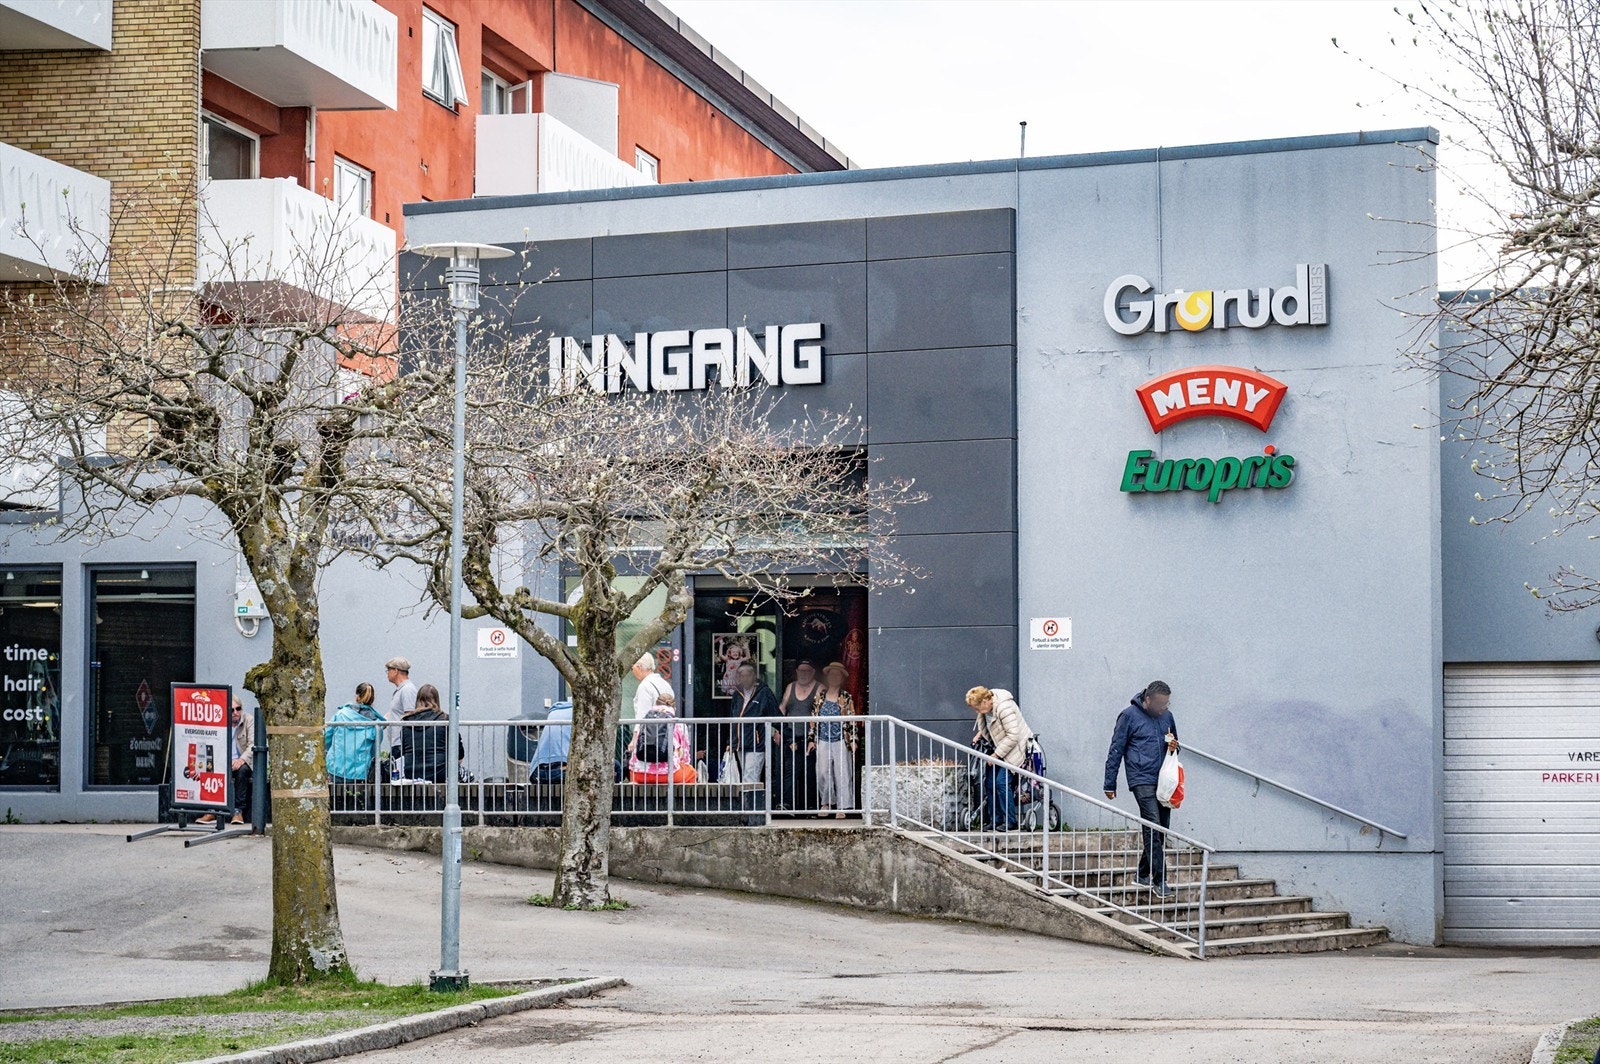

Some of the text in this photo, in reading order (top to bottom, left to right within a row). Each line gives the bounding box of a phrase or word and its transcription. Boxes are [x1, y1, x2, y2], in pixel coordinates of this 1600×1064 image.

[1311, 265, 1324, 323] SENTER
[548, 322, 824, 394] INNGANG
[1150, 377, 1270, 417] MENY
[1120, 444, 1296, 503] Europris
